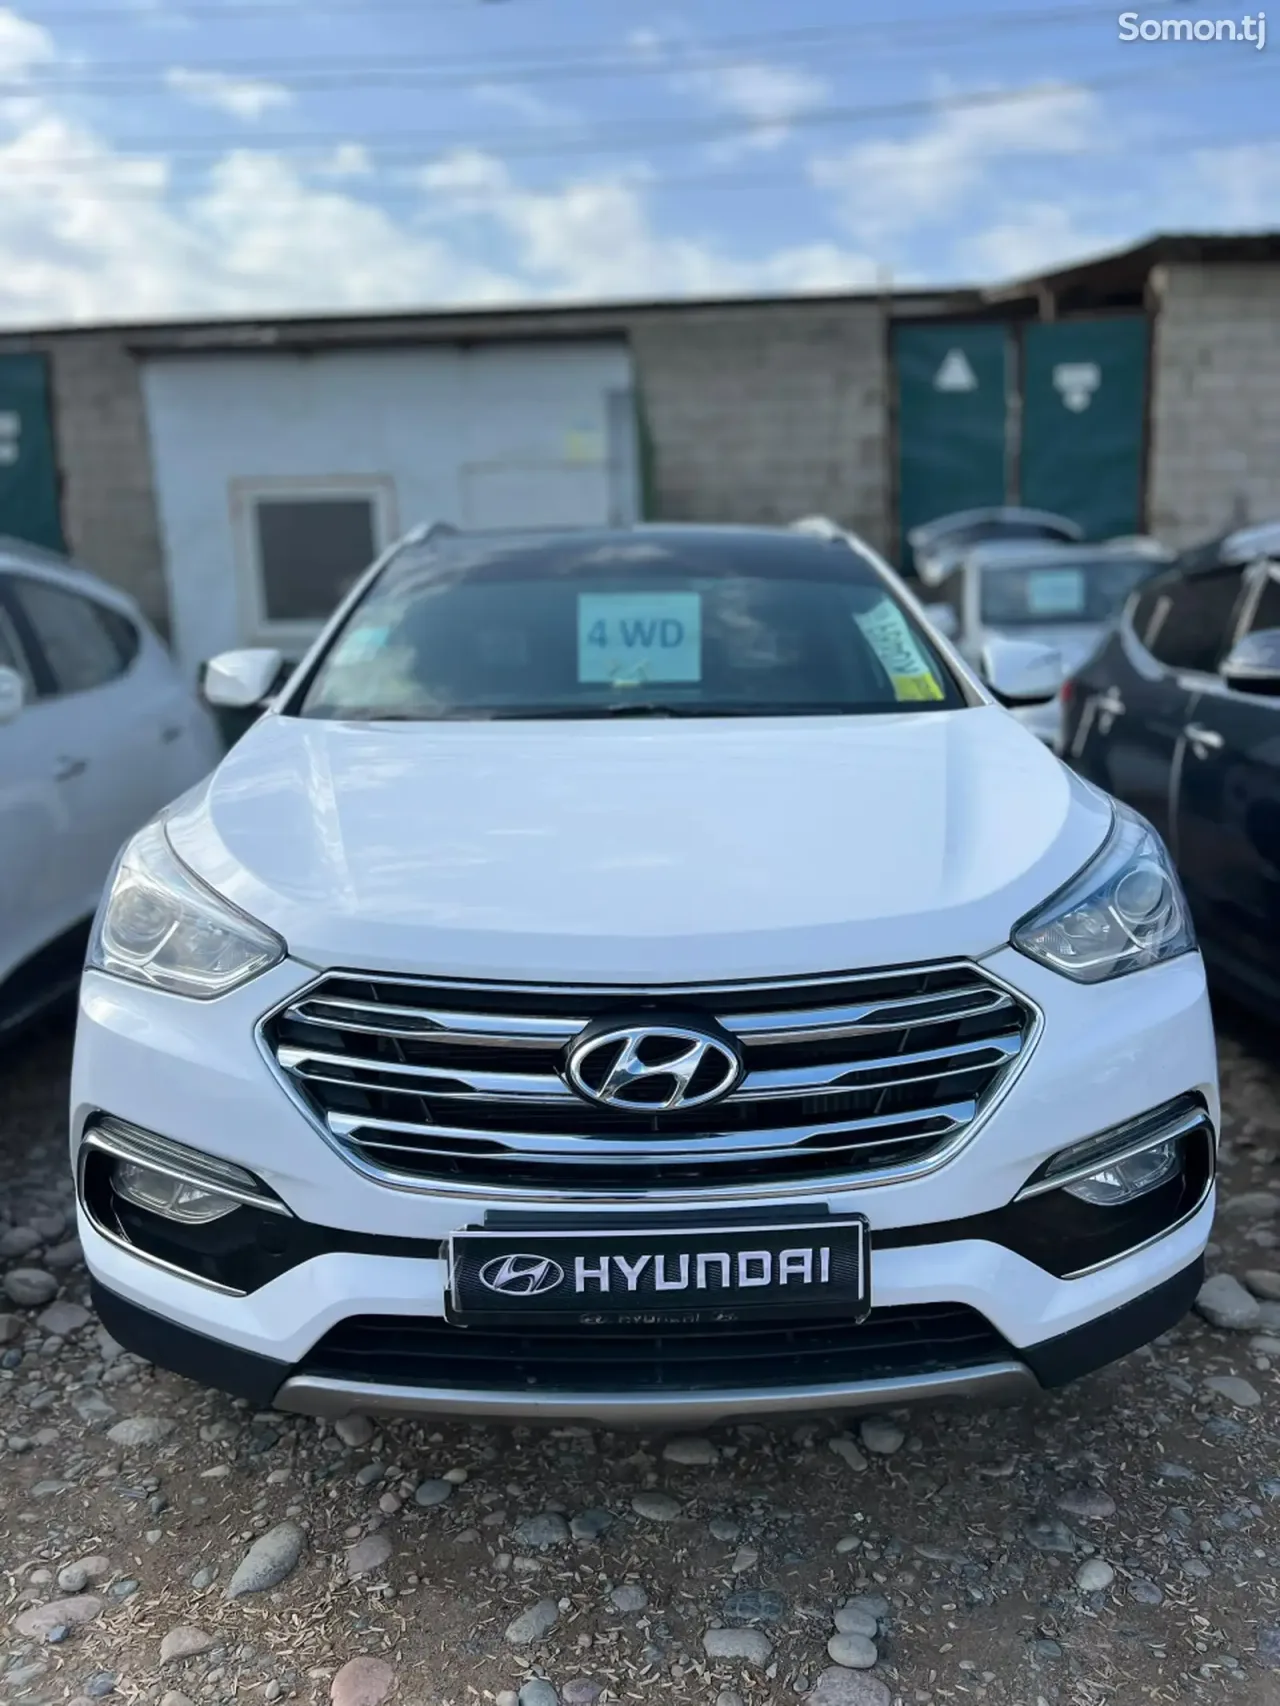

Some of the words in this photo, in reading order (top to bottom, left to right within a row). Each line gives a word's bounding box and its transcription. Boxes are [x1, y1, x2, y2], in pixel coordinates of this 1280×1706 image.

[588, 619, 608, 649] 4
[621, 619, 685, 649] WD
[574, 1247, 830, 1293] HYUNDAI
